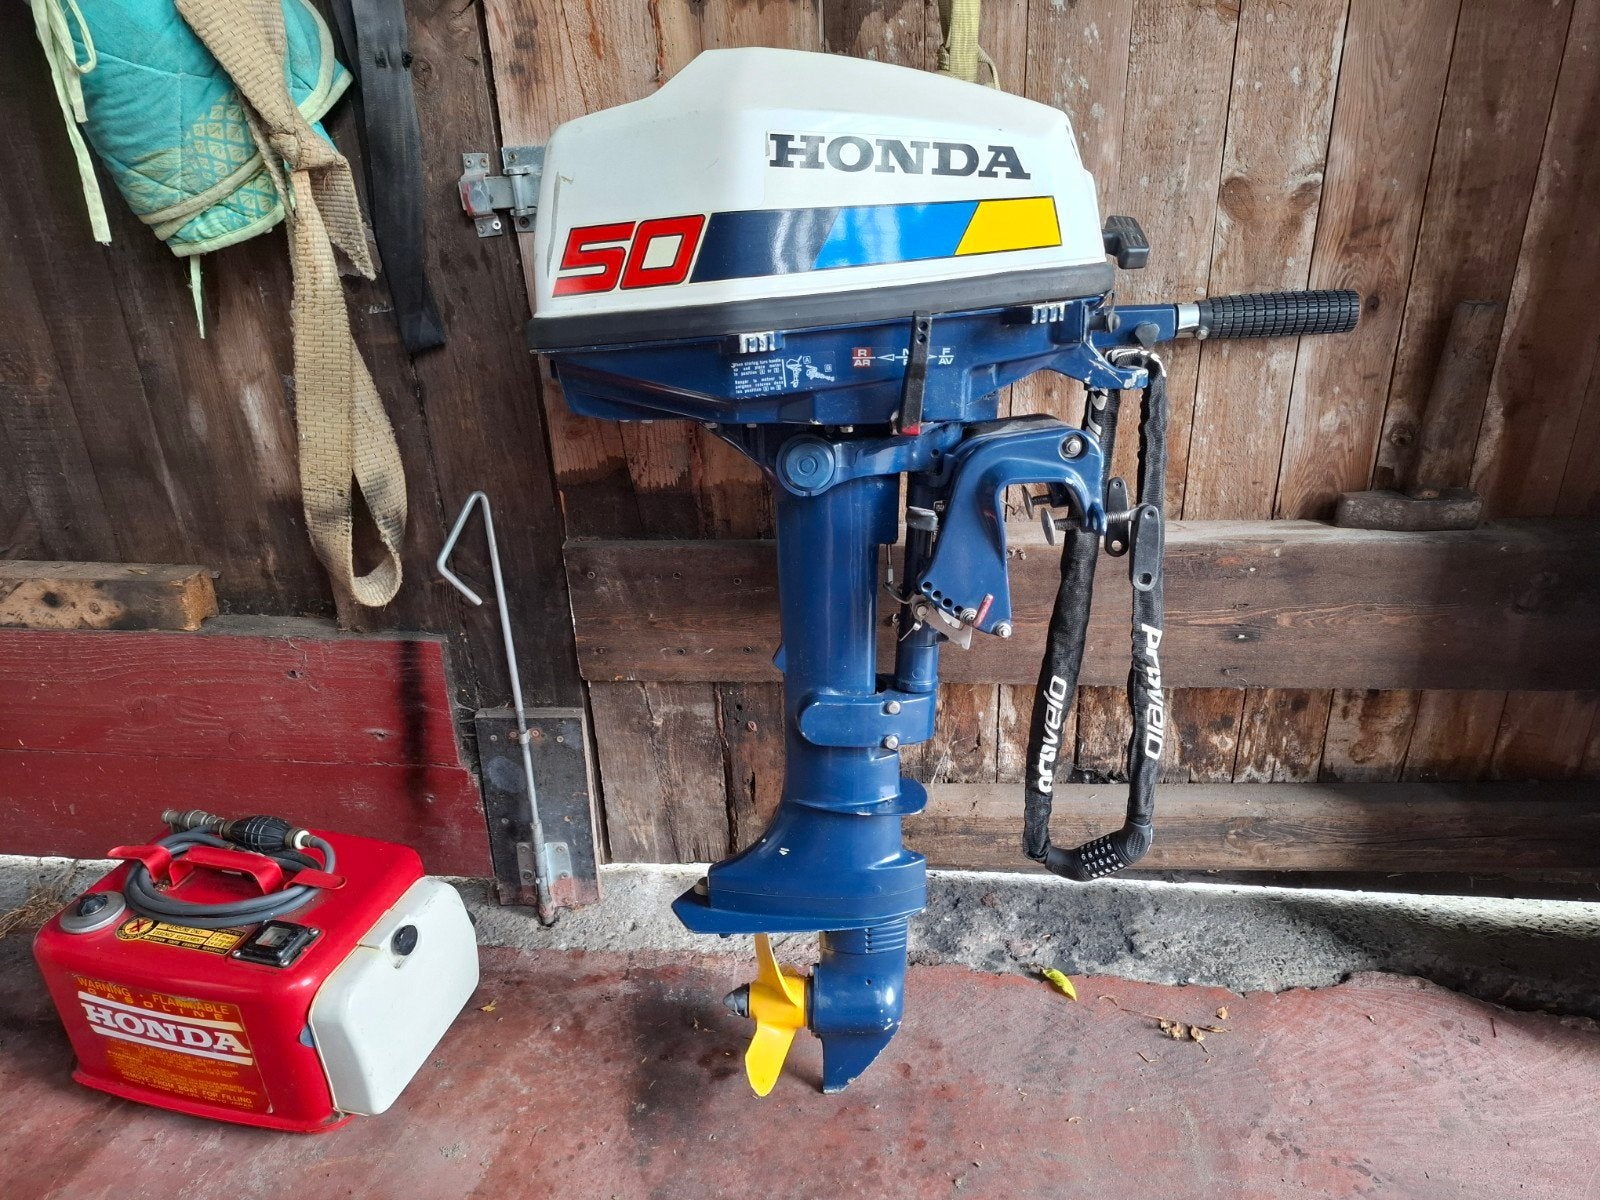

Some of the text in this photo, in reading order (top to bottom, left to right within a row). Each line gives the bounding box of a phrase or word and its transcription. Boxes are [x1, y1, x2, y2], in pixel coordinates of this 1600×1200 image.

[769, 133, 1031, 180] HONDA
[552, 214, 706, 297] 50
[853, 359, 871, 367] AR
[857, 348, 867, 357] R
[938, 357, 955, 365] AV
[942, 347, 951, 355] F
[1141, 623, 1164, 760] provelo
[77, 977, 230, 1015] WARNING FLAMMABLE
[87, 988, 224, 1021] GASOLINE
[80, 1002, 251, 1054] HONDA
[202, 1090, 219, 1098] FOR
[221, 1093, 253, 1104] FILLING
